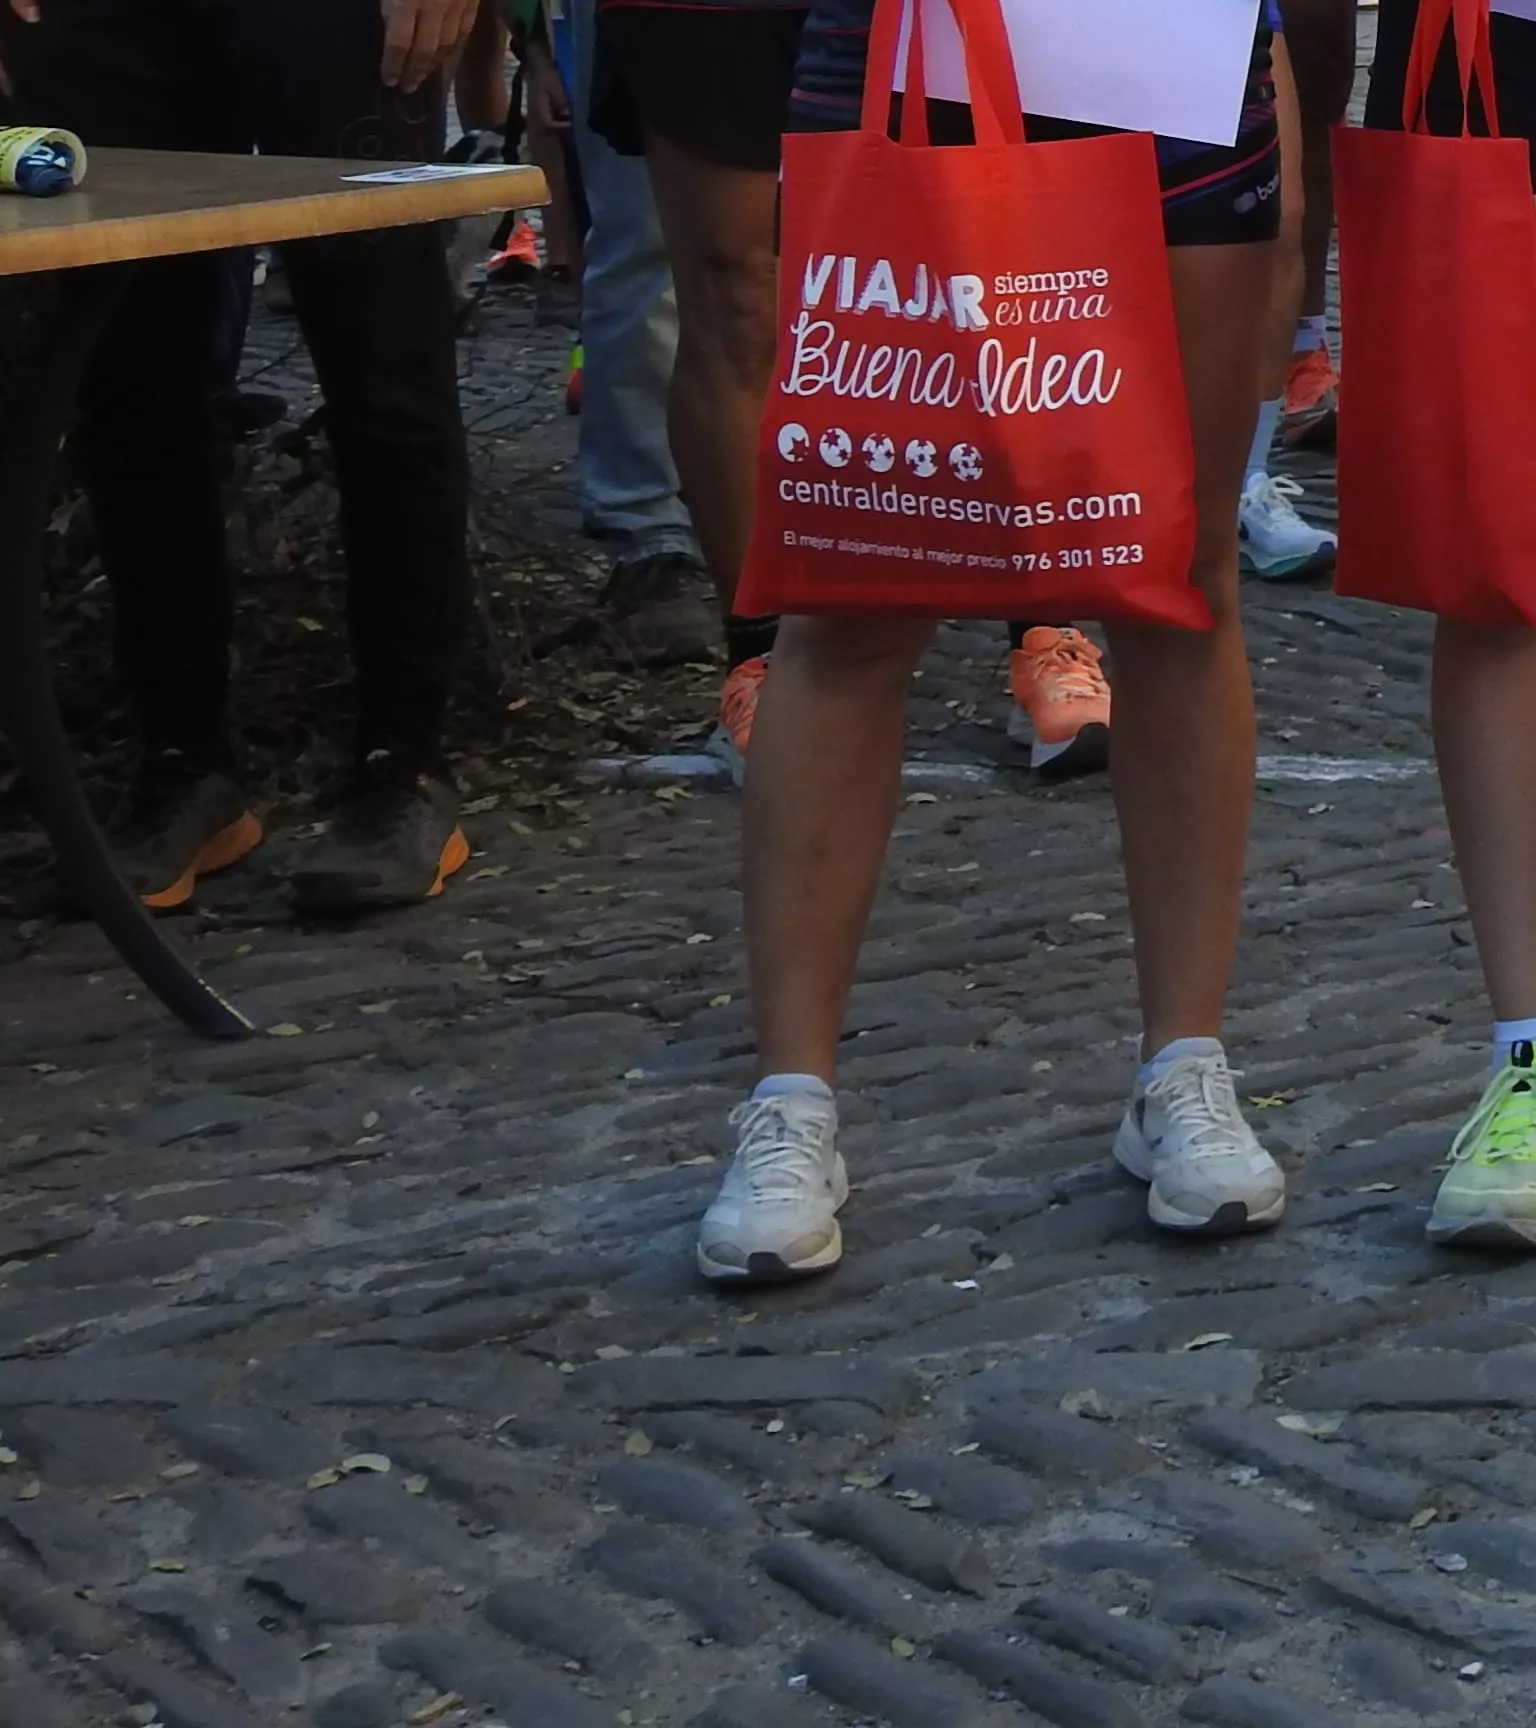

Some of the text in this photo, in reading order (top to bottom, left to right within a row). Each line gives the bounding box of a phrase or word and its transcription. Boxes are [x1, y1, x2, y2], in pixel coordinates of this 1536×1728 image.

[803, 252, 1108, 332] VIAJAR siempre
[995, 294, 1112, 327] es una
[780, 310, 1122, 418] Buena Idea
[779, 478, 1143, 529] centraldereservas.com
[784, 530, 1144, 572] El mejor alojamiento al mejor precio 976 301 523
